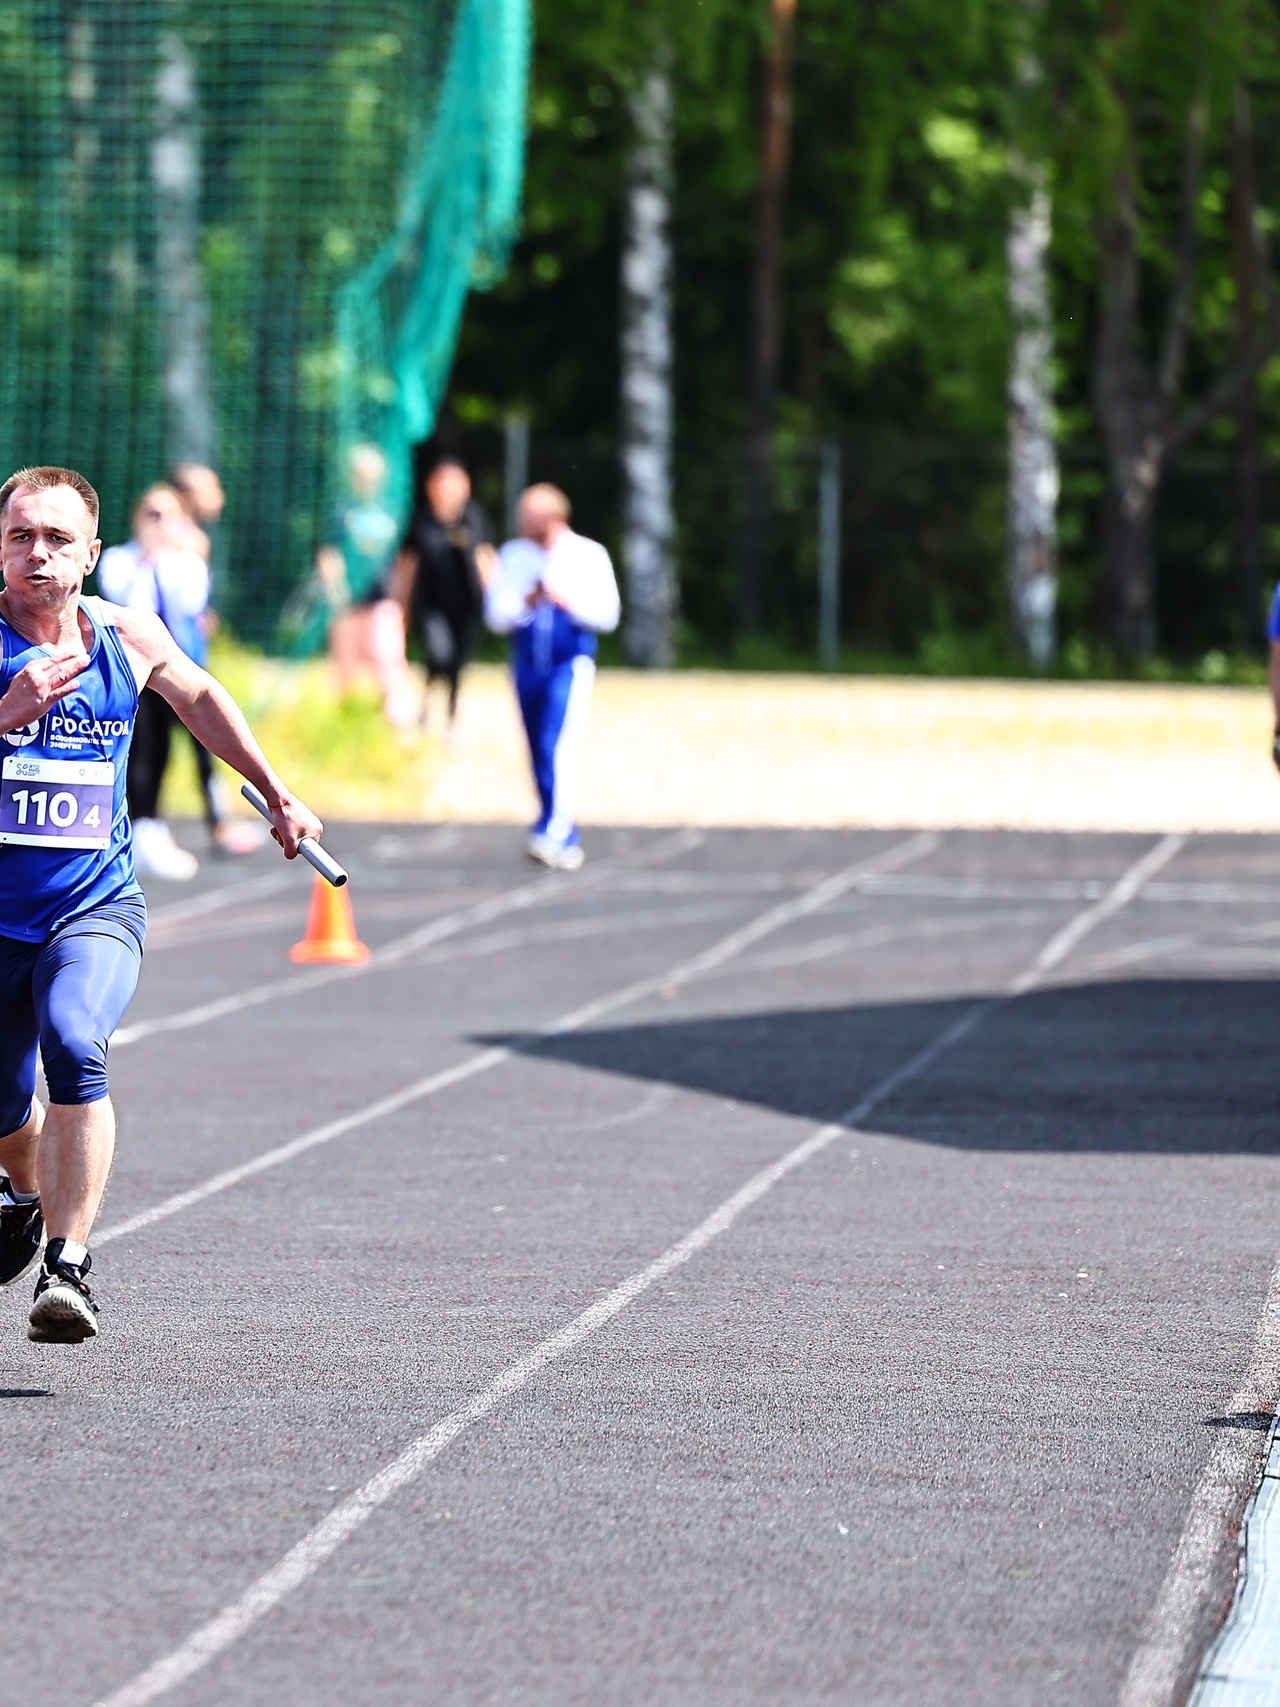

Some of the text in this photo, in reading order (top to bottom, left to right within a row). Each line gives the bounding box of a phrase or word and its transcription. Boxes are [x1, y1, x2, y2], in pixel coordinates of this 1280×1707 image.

[49, 741, 82, 750] ЭНЕРГИЯ
[11, 789, 101, 829] 110 4
